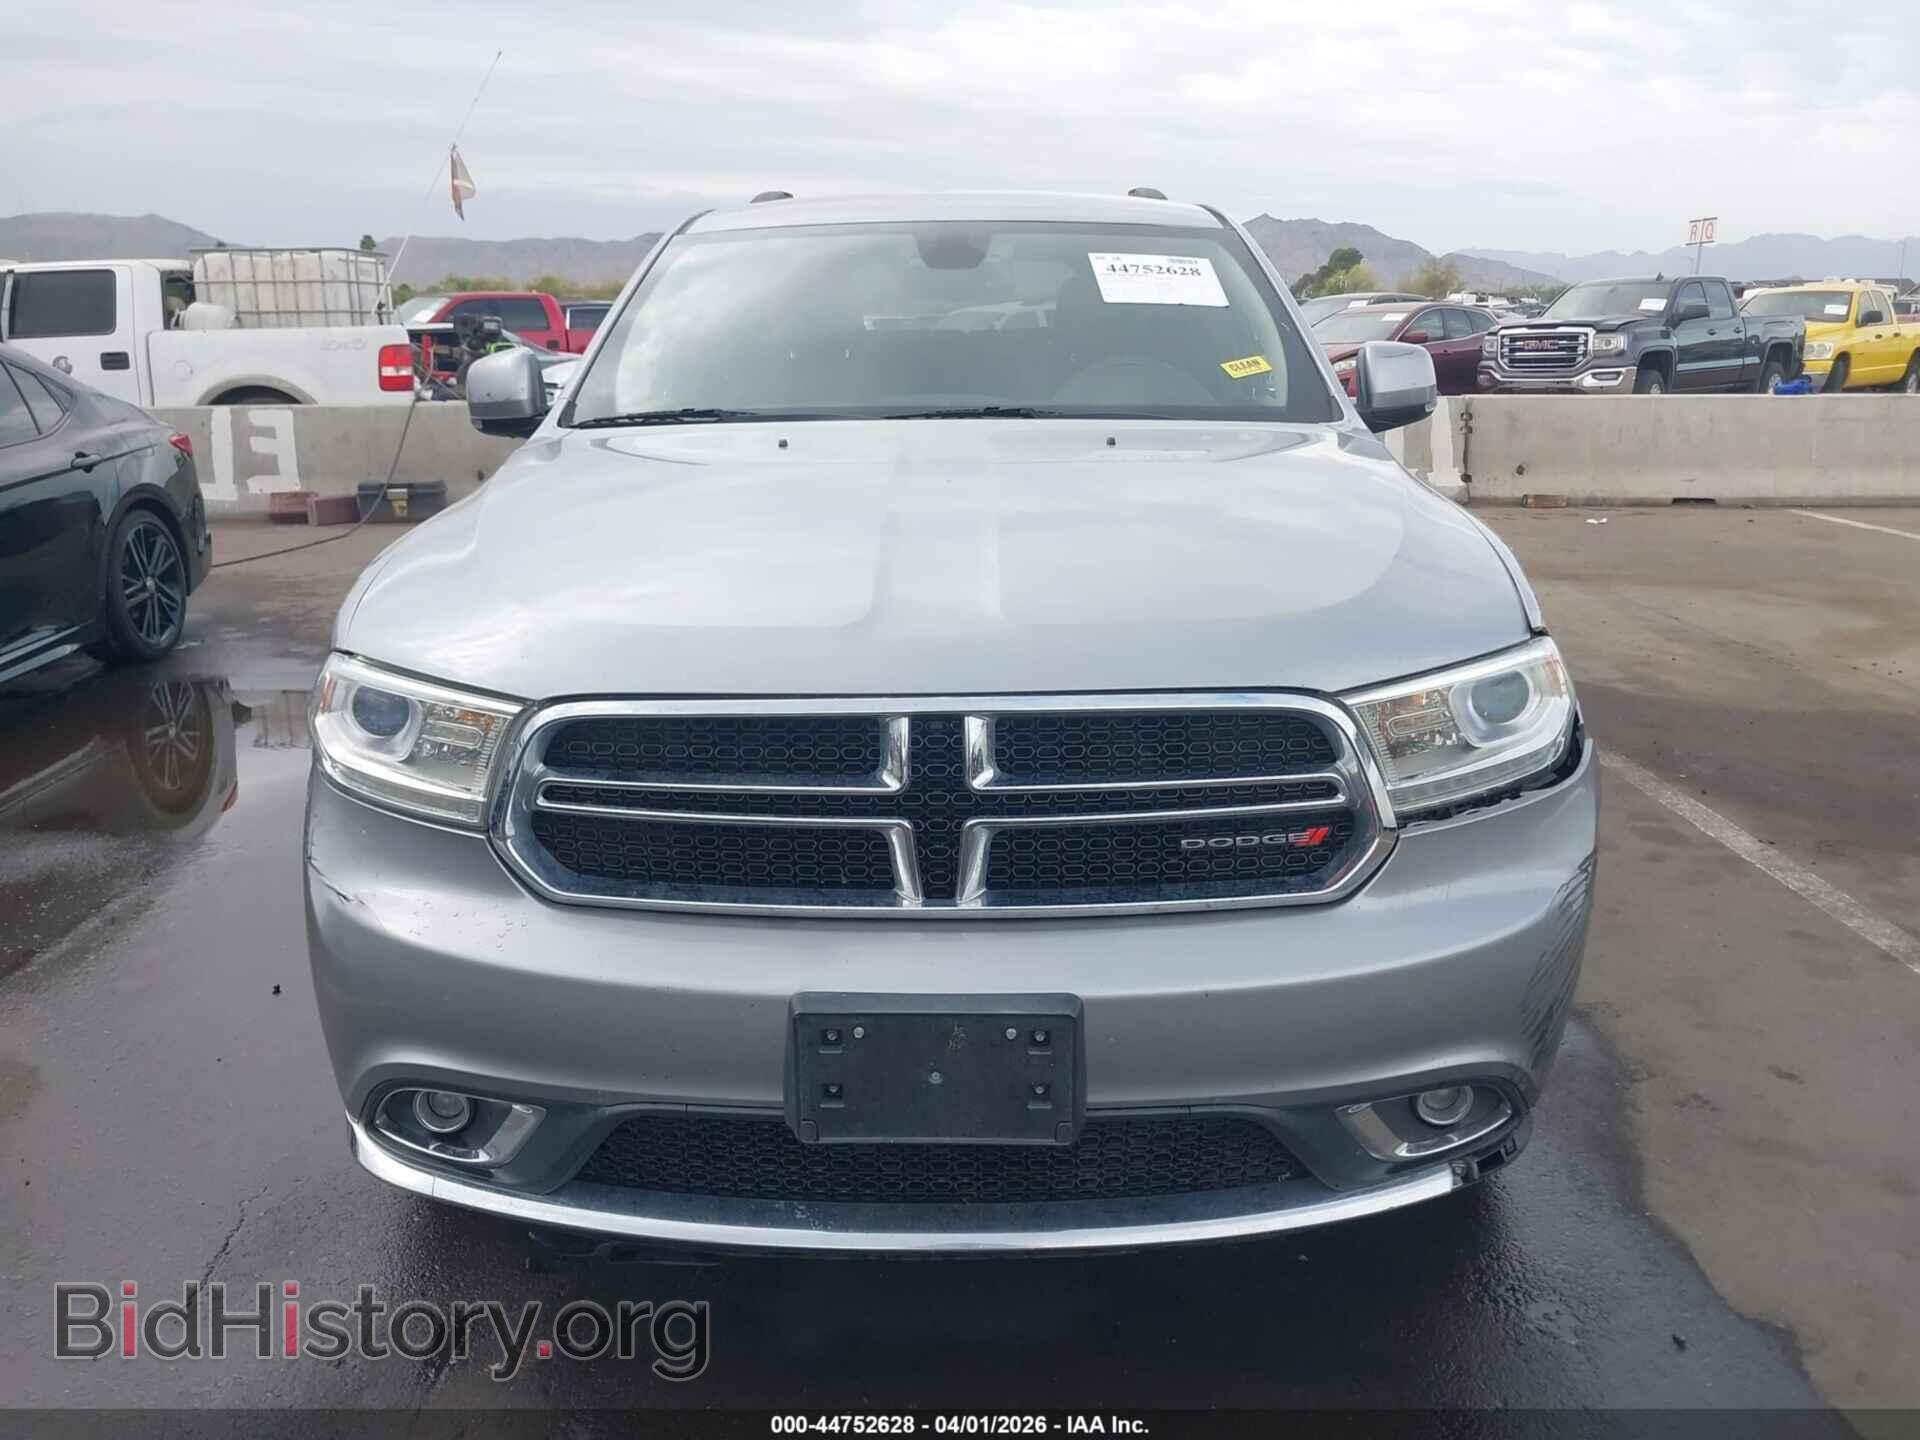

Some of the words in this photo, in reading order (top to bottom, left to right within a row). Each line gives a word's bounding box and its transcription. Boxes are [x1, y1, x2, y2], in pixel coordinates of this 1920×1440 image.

[1106, 264, 1201, 276] 44752628
[1523, 339, 1559, 350] GMC
[1228, 359, 1262, 372] CLEAN
[1180, 832, 1311, 849] DODGE
